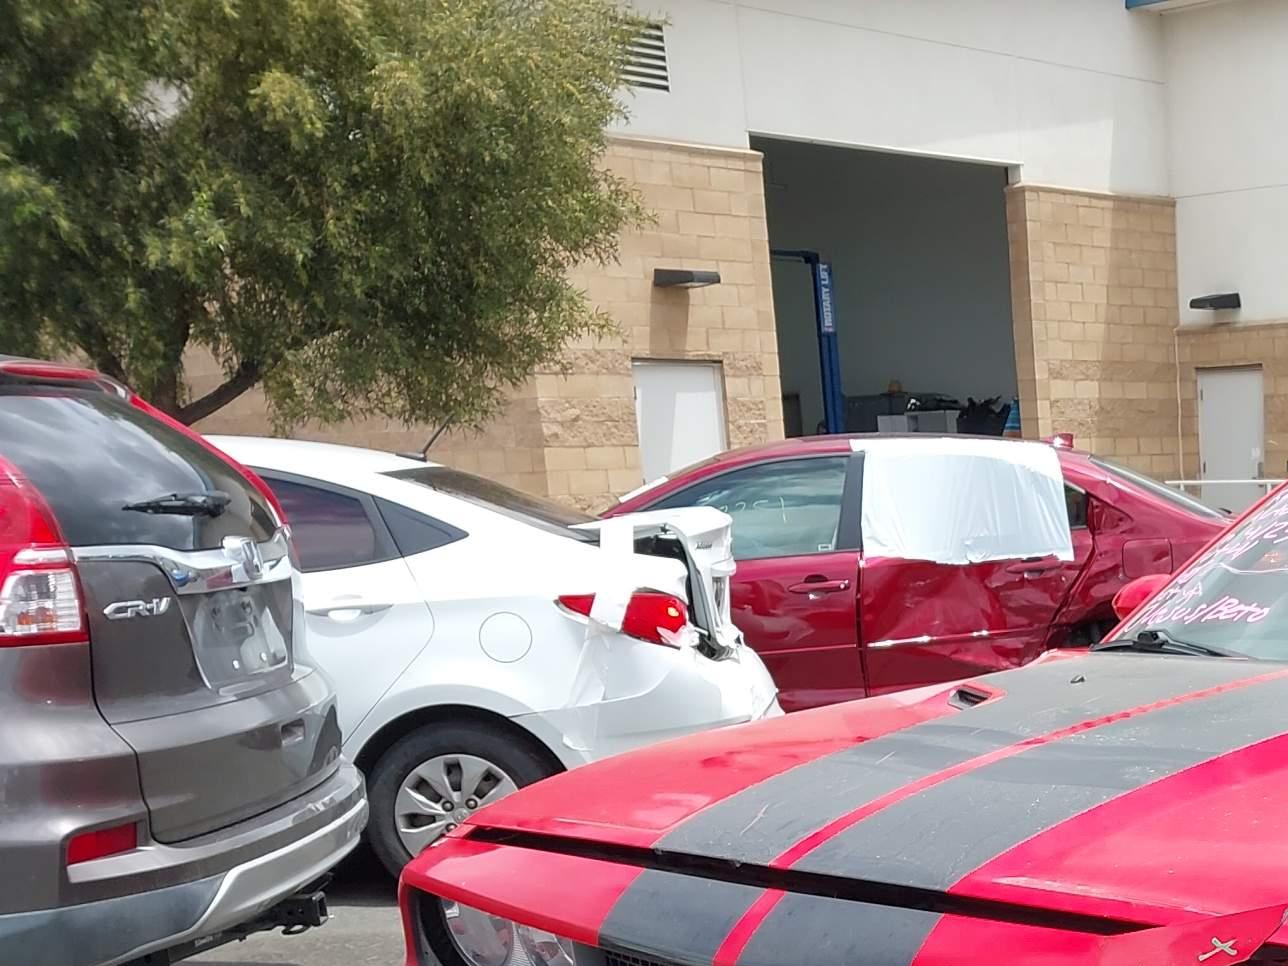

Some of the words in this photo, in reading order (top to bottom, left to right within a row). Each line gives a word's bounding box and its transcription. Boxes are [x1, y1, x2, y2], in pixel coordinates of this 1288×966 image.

[820, 264, 829, 284] LIFT
[822, 287, 832, 326] ROTARY
[103, 597, 171, 620] CR-V
